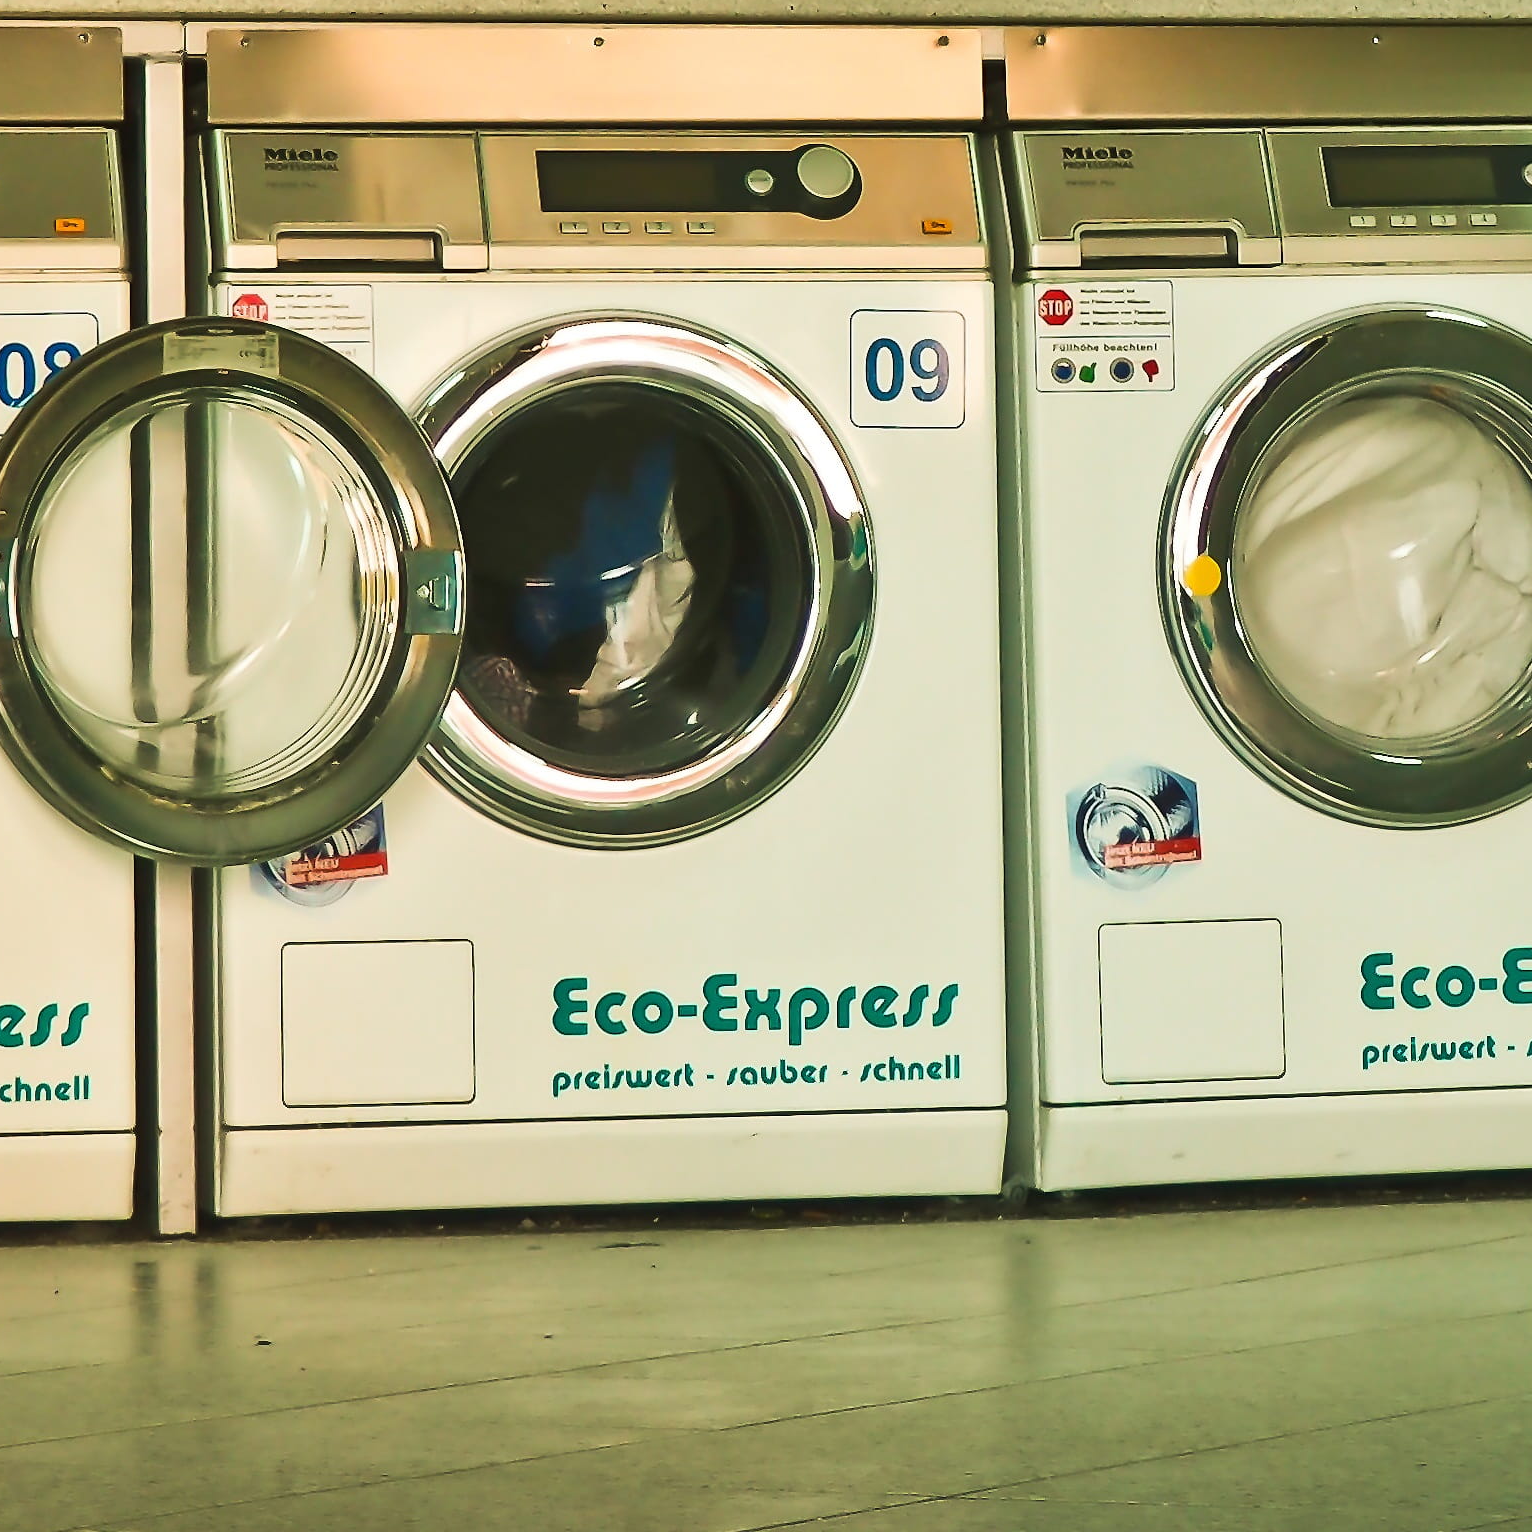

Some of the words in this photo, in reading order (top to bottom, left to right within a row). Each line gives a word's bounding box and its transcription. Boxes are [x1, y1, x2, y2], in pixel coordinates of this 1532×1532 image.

[264, 147, 339, 161] Miele
[1061, 147, 1133, 159] Miele
[1038, 300, 1073, 318] STOP
[864, 337, 950, 403] 09
[552, 972, 961, 1047] Eco-Express
[1362, 1035, 1496, 1070] preiswert
[552, 1063, 695, 1097] preiswert
[726, 1059, 829, 1086] sauber
[859, 1054, 961, 1082] schnell
